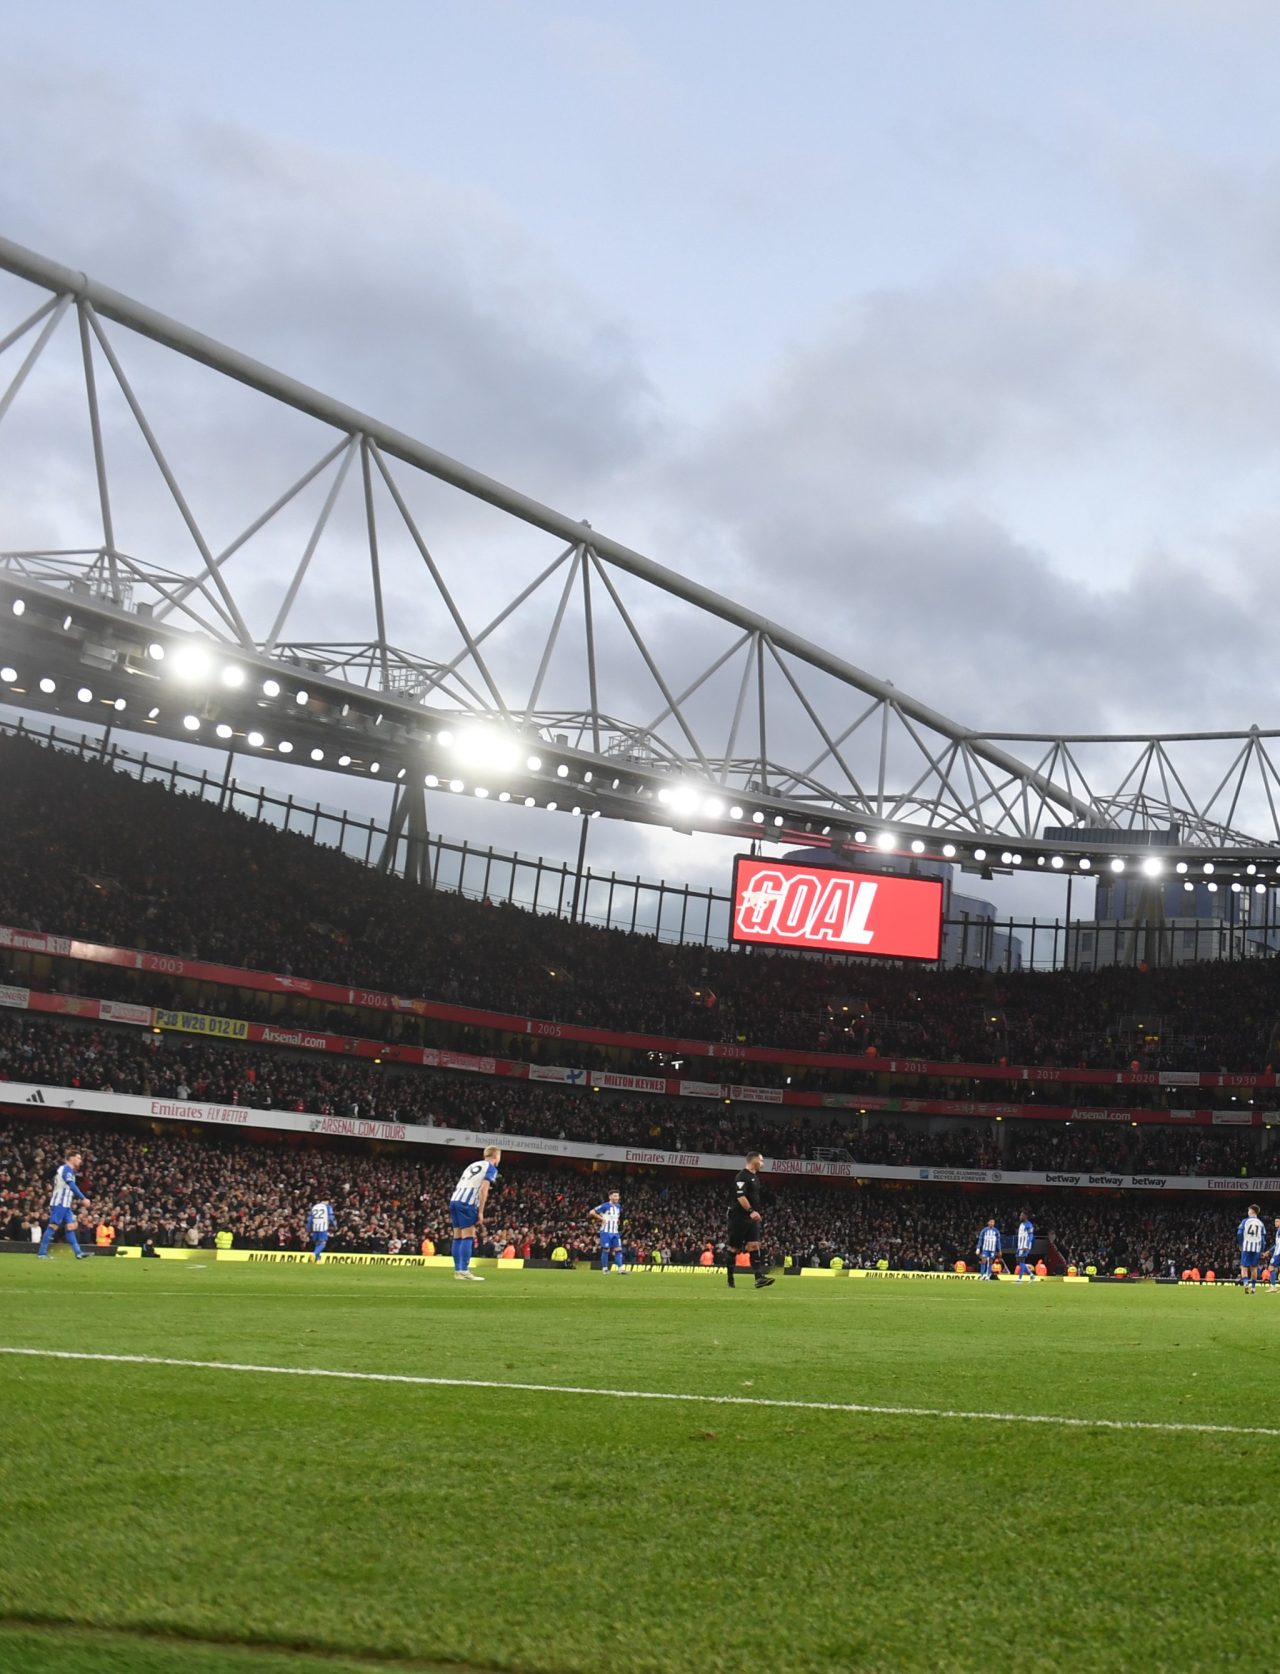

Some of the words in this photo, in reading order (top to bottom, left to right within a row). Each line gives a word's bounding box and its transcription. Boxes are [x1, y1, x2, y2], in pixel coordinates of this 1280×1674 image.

[737, 870, 878, 944] GOAL
[151, 957, 184, 973] 2003
[361, 993, 388, 1008] 2004
[156, 1010, 178, 1027] P38
[182, 1014, 205, 1031] W26
[208, 1018, 230, 1035] D12
[538, 1023, 562, 1037] 2005
[262, 1028, 326, 1049] Arsenal.com
[722, 1046, 746, 1058] 2014
[904, 1062, 928, 1073] 2015
[1037, 1069, 1060, 1080] 2017
[1130, 1074, 1155, 1083] 2020
[1230, 1076, 1256, 1085] 1930
[604, 1074, 634, 1089] MILTON
[635, 1079, 664, 1091] KEYNES
[151, 1101, 203, 1119] Emirates
[207, 1107, 221, 1121] FLY
[221, 1109, 248, 1123] BETTER
[1071, 1109, 1131, 1121] Arsenal.com
[321, 1118, 406, 1139] ARSENAL.COM/TOURS
[625, 1150, 665, 1163] Emirates
[667, 1153, 679, 1164] FLY
[679, 1155, 700, 1166] BETTER
[771, 1160, 851, 1176] ARSENAL.COM/TOURS
[1046, 1174, 1080, 1185] betway
[1089, 1175, 1124, 1186] betway
[1132, 1176, 1167, 1187] betway
[1207, 1180, 1249, 1189] Emirates
[1252, 1180, 1264, 1189] FLY
[312, 1208, 325, 1220] 22
[1247, 1224, 1259, 1237] 41
